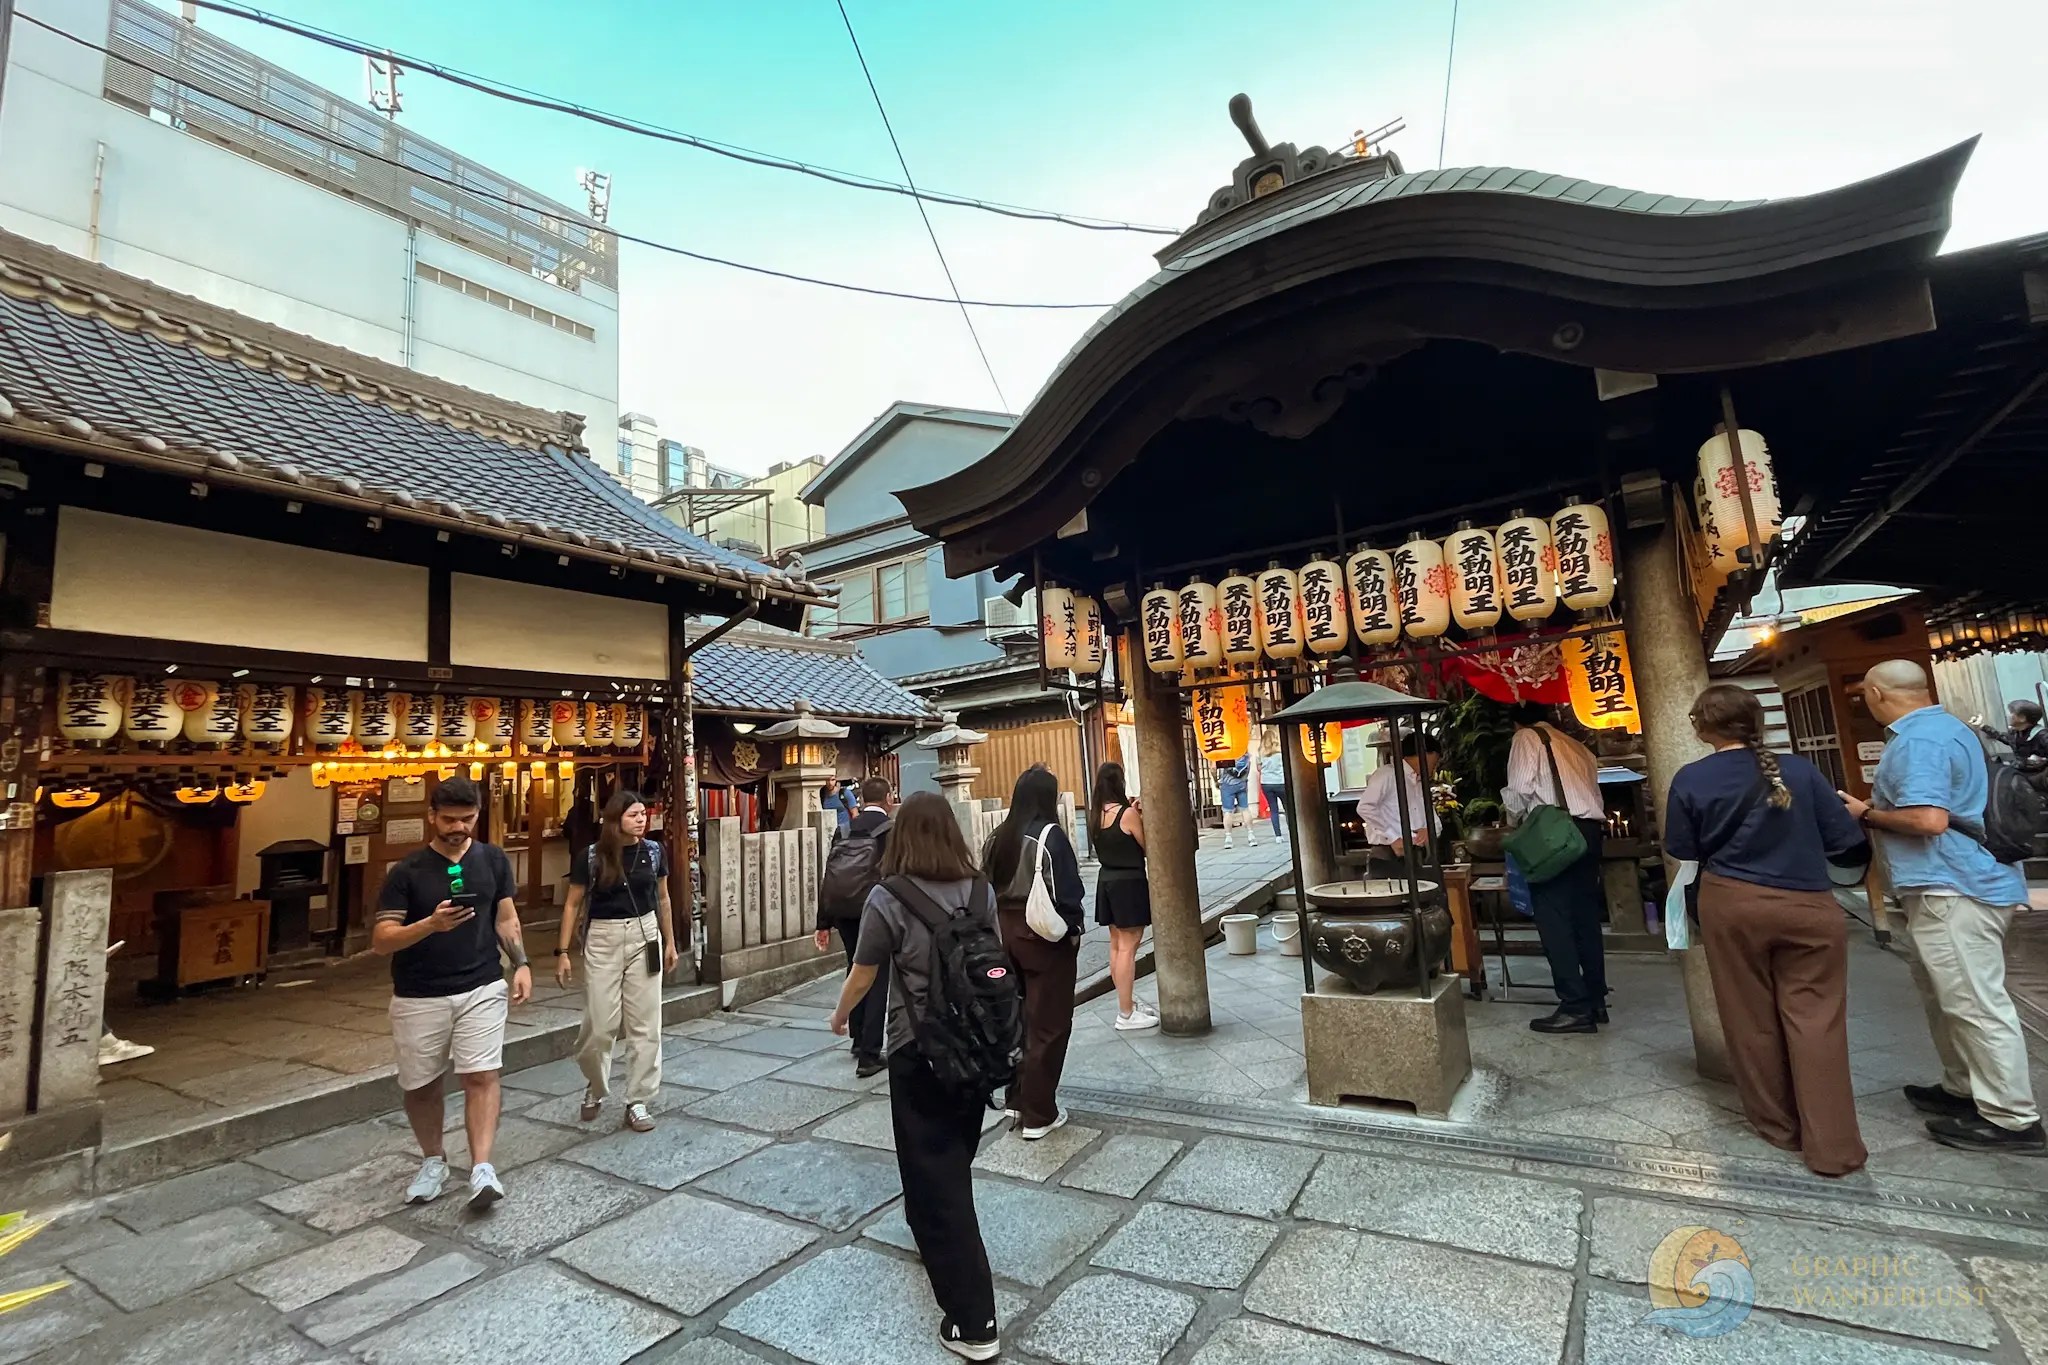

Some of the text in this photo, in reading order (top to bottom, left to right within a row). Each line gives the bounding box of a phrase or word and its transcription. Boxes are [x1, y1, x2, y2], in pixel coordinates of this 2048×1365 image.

[1458, 535, 1498, 615] 不動明王
[1501, 526, 1545, 609] 不動明王
[1554, 513, 1598, 598] 不動明王
[1145, 596, 1175, 663] 不動明王
[1179, 590, 1207, 659] 不動明王
[1224, 583, 1255, 653] 不動明王
[1262, 575, 1296, 647] 不動明王
[1302, 568, 1338, 643] 不動明王
[1354, 557, 1393, 633] 不動明王
